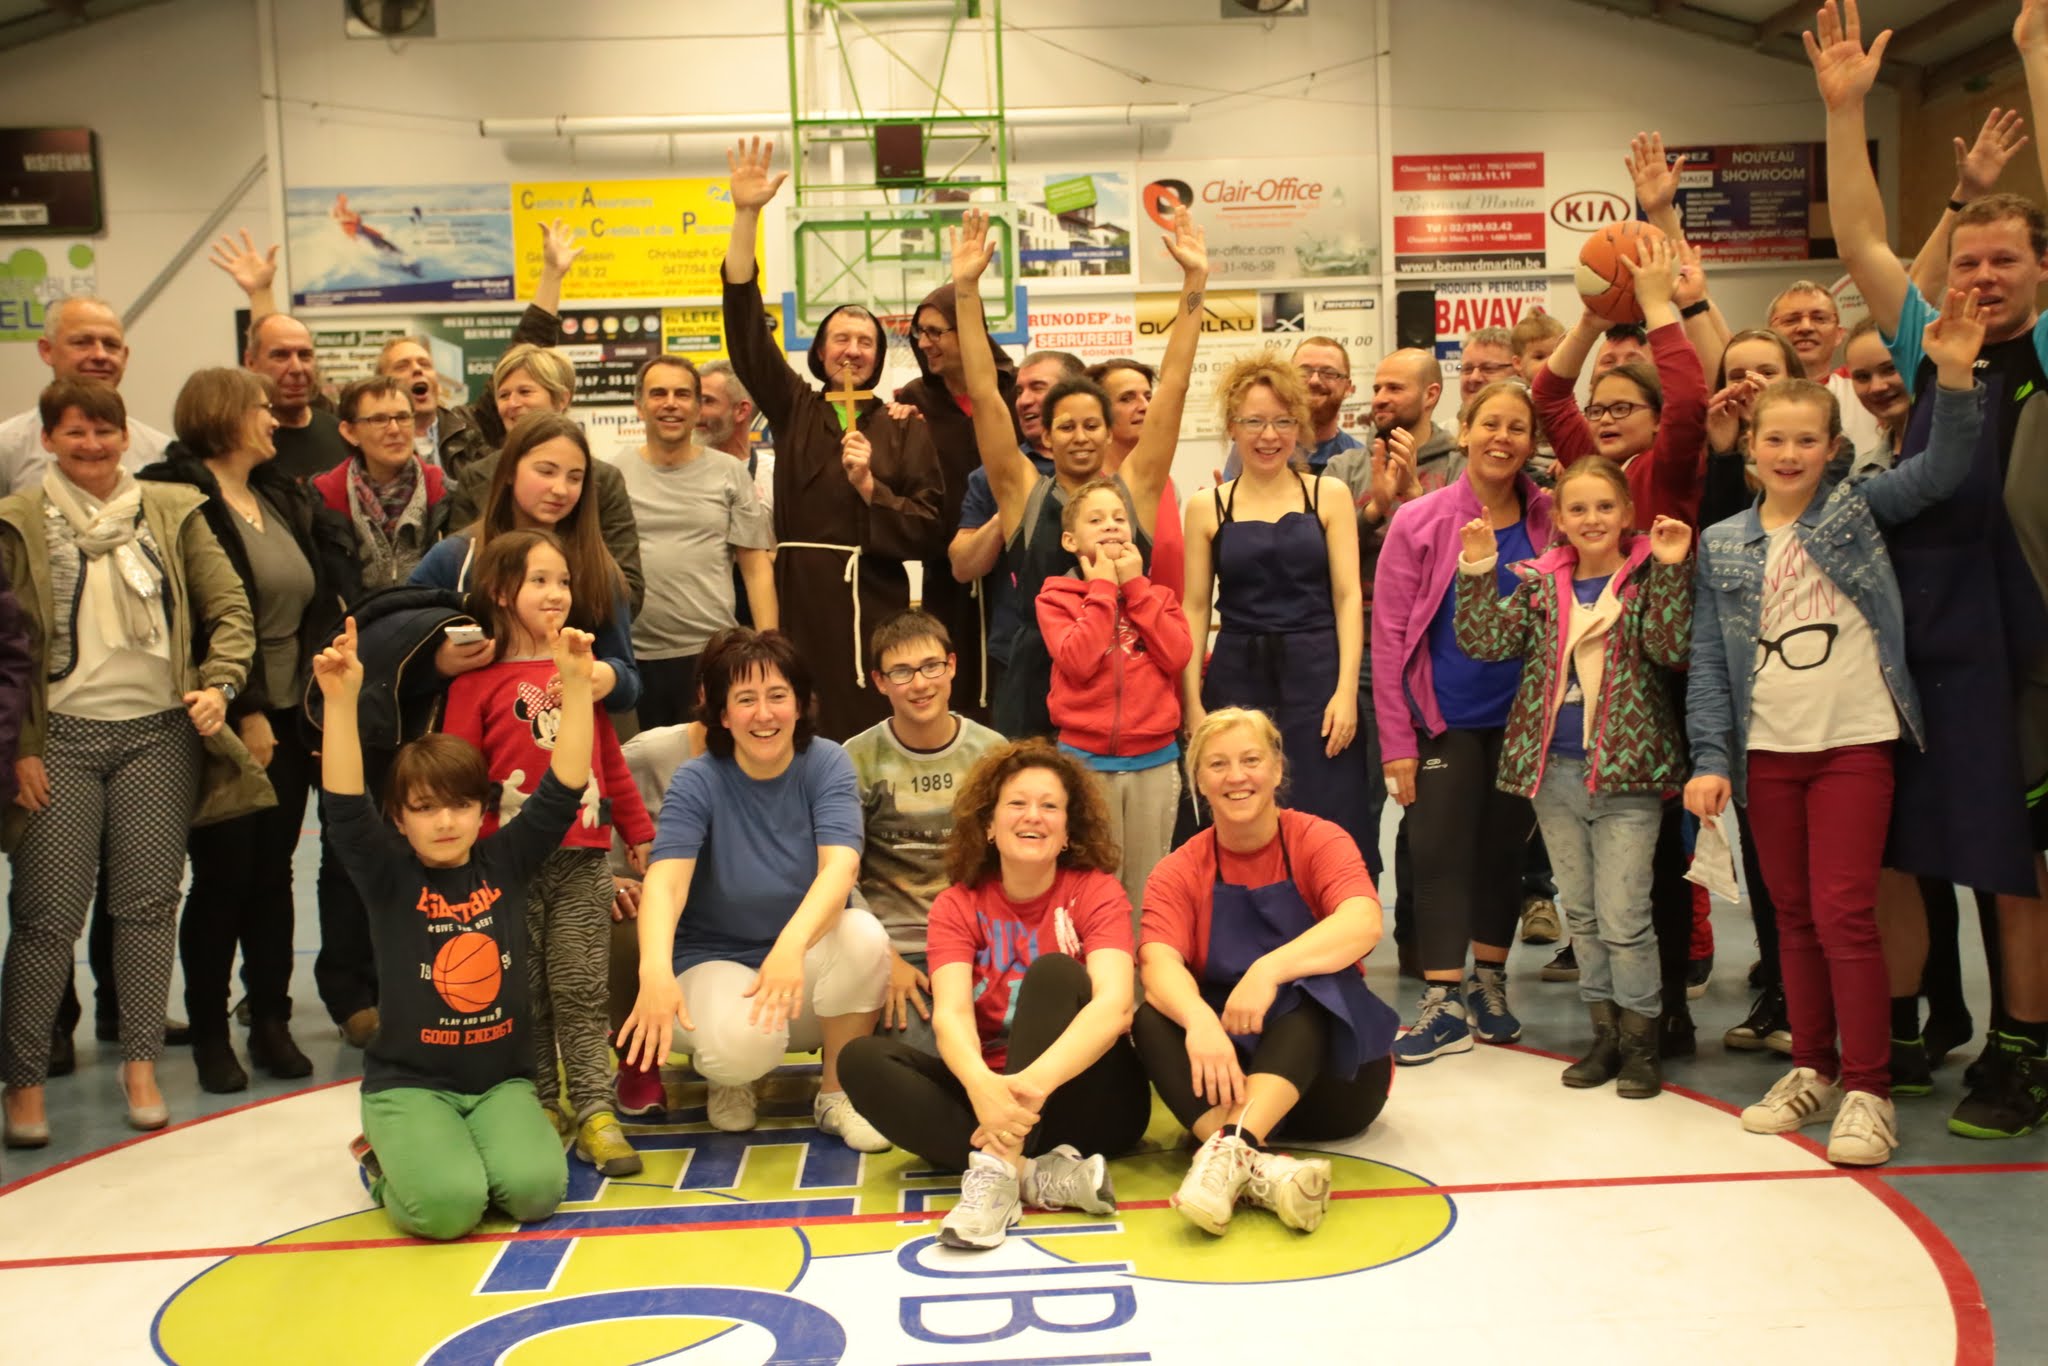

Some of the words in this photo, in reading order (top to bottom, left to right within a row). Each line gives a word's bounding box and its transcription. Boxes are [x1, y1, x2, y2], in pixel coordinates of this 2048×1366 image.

[1732, 151, 1795, 164] NOUVEAU
[1721, 168, 1805, 183] SHOWROOM
[1202, 177, 1323, 204] Clair-Office
[1565, 200, 1617, 223] KIA
[1400, 258, 1541, 272] www.bernardmartin.be
[1435, 282, 1482, 295] PRODUITS
[1488, 280, 1547, 293] PETROLIERS
[1037, 331, 1131, 348] SERRURERIE
[911, 773, 953, 793] 1989
[439, 1017, 461, 1026] PLAY
[462, 1017, 478, 1026] AND
[420, 1028, 460, 1045] GOOD
